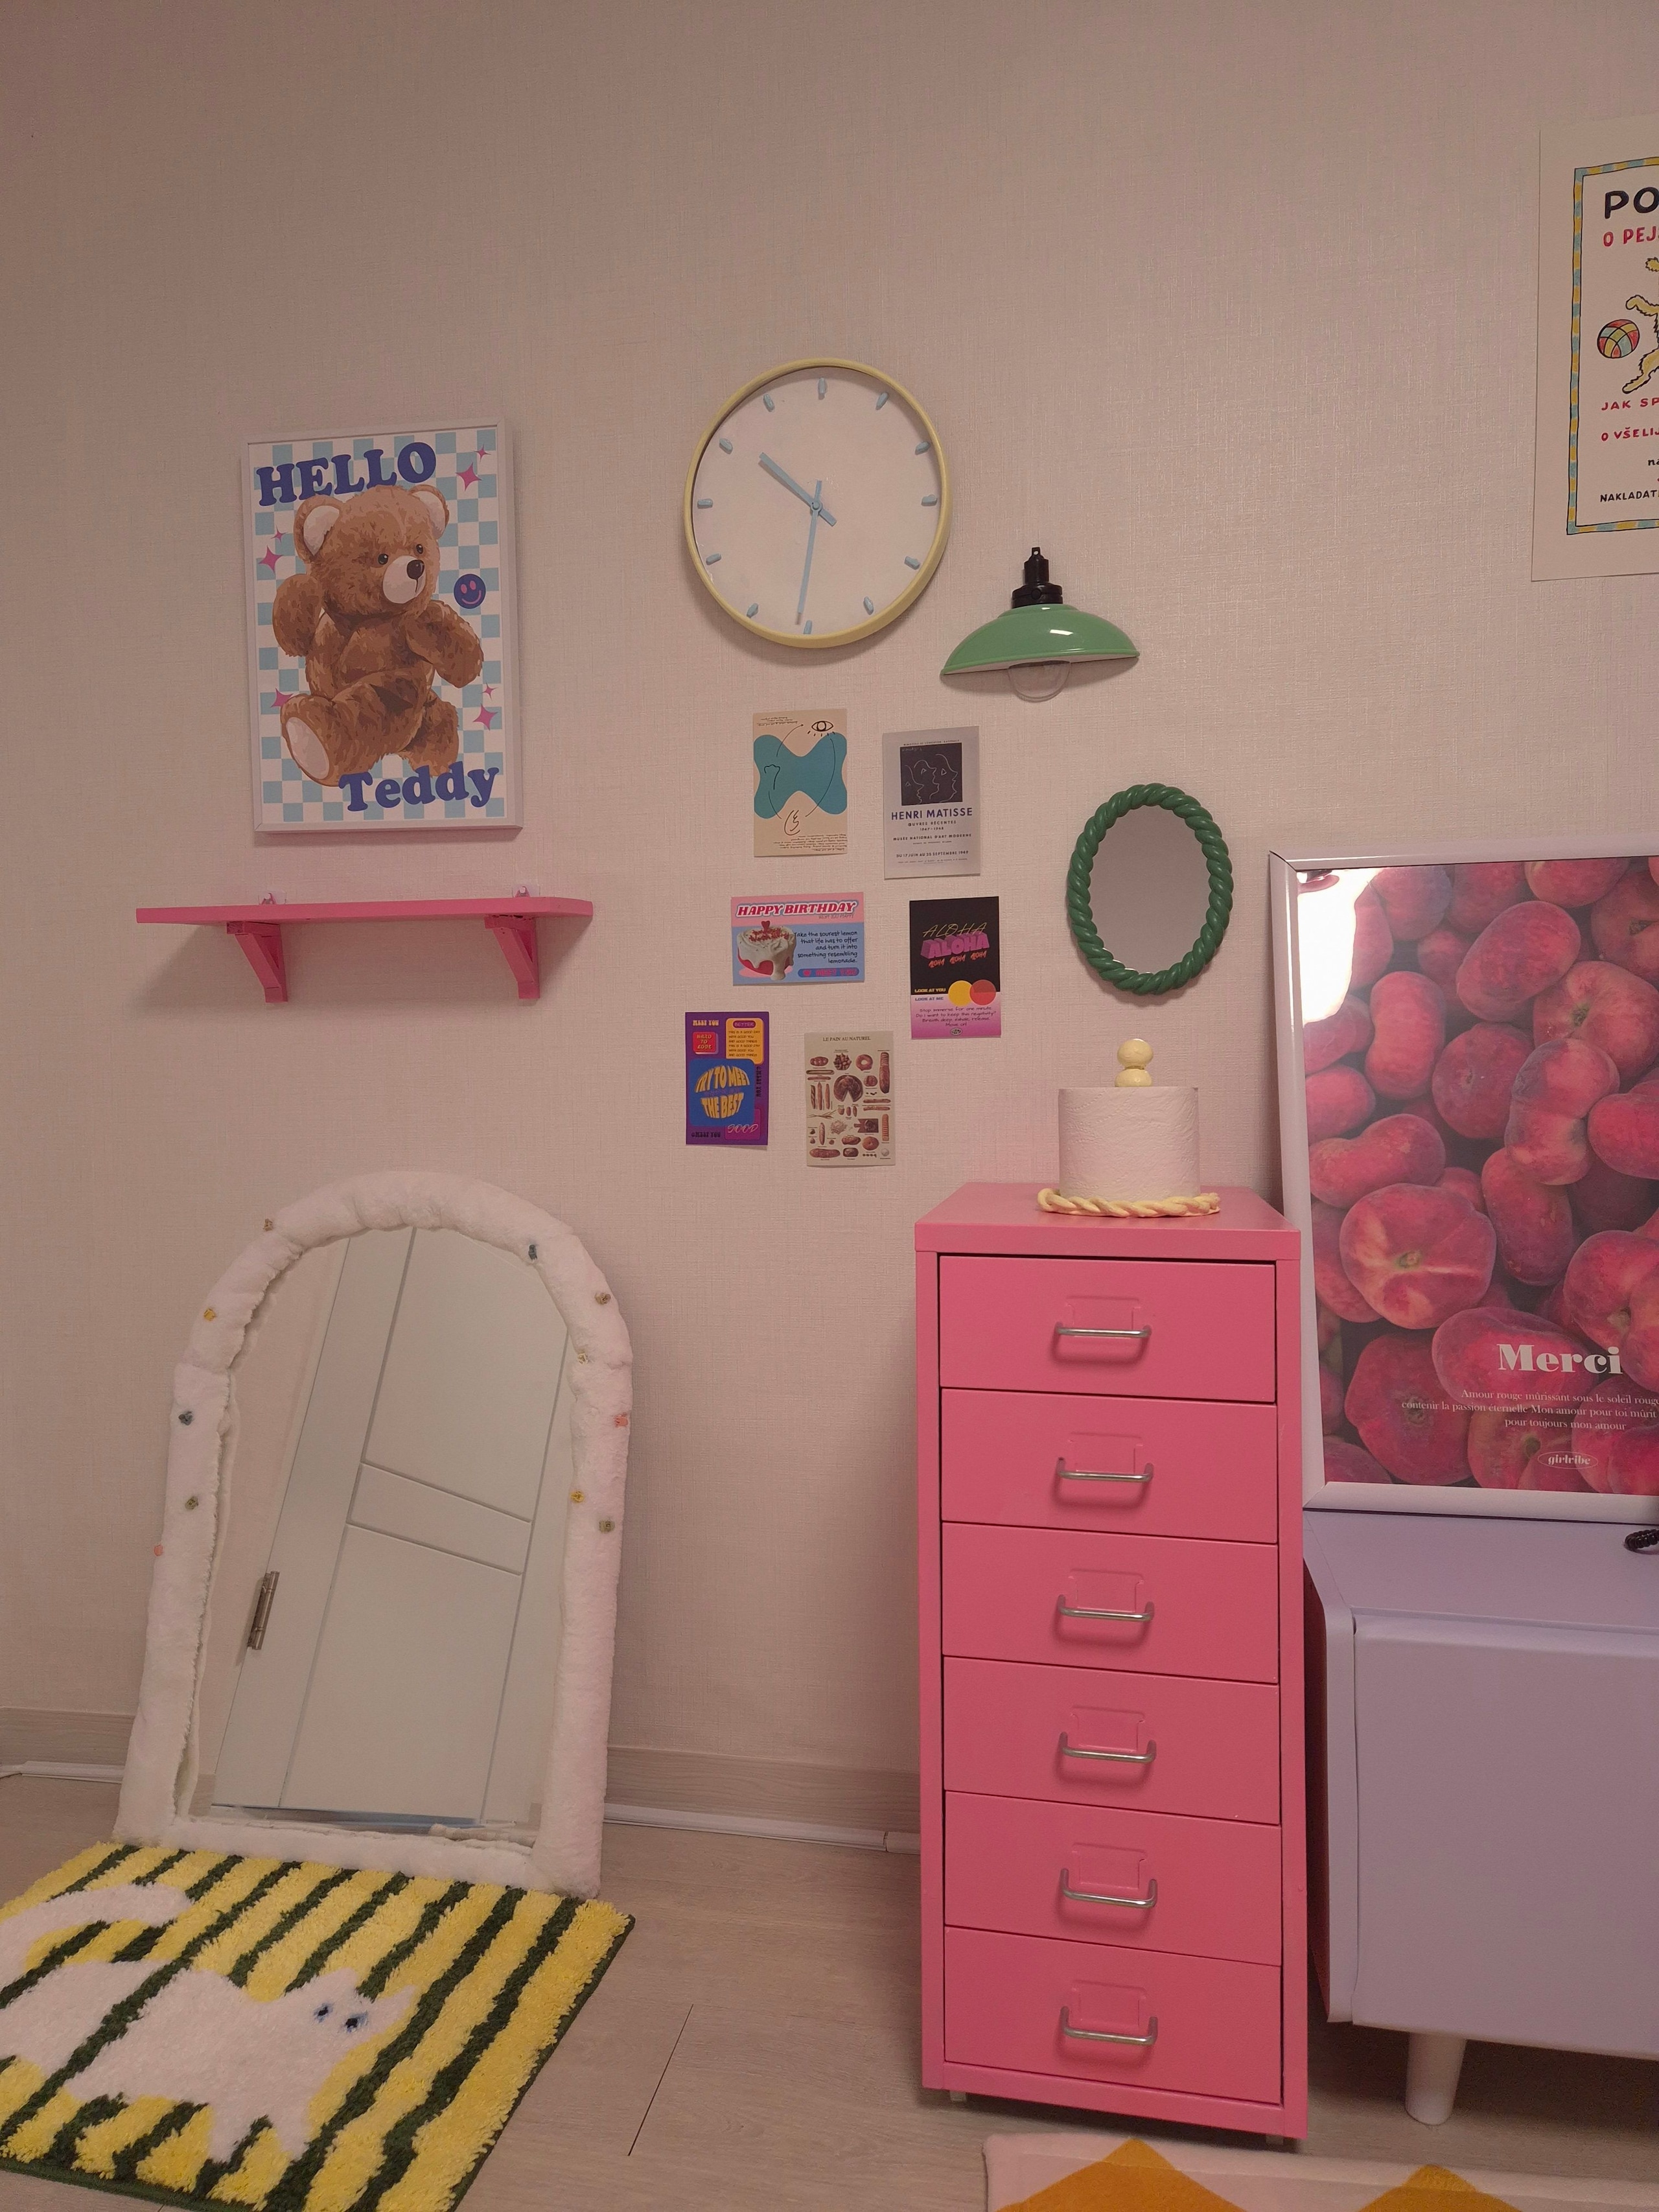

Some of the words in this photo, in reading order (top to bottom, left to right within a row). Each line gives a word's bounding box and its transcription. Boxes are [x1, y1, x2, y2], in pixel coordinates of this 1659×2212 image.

[1603, 231, 1614, 247] O
[1622, 226, 1659, 244] PEJ
[1601, 400, 1631, 411] JAK
[1601, 432, 1608, 441] O
[256, 441, 437, 507] HELLO
[1600, 489, 1659, 502] NAKLADAT
[338, 760, 500, 812] Teddy
[891, 810, 922, 820] HENRI
[926, 808, 973, 818] MATISSE
[737, 904, 783, 916] HAPPY
[783, 902, 856, 914] BIRTHDAY
[922, 922, 987, 937] ALOHA
[921, 931, 990, 959] ALOHA
[714, 1065, 727, 1089] TO
[727, 1065, 750, 1088] MEET
[701, 1096, 720, 1119] THE
[720, 1092, 745, 1119] BEST
[1496, 1343, 1623, 1375] Merci
[1461, 1389, 1494, 1399] Amour
[1497, 1391, 1523, 1401] rouge
[1526, 1391, 1570, 1402] mûrissant
[1572, 1394, 1594, 1403] sous
[1596, 1393, 1605, 1403] le
[1607, 1395, 1632, 1404] soleil
[1402, 1401, 1439, 1410] contenir
[1442, 1401, 1450, 1410] la
[1452, 1403, 1486, 1412] passion
[1489, 1403, 1528, 1413] éternelle
[1531, 1404, 1553, 1414] Mon
[1590, 1409, 1612, 1418] pour
[1615, 1408, 1628, 1417] toi
[1505, 1419, 1527, 1428] pour
[1529, 1418, 1568, 1429] toujours
[1595, 1422, 1627, 1430] amour
